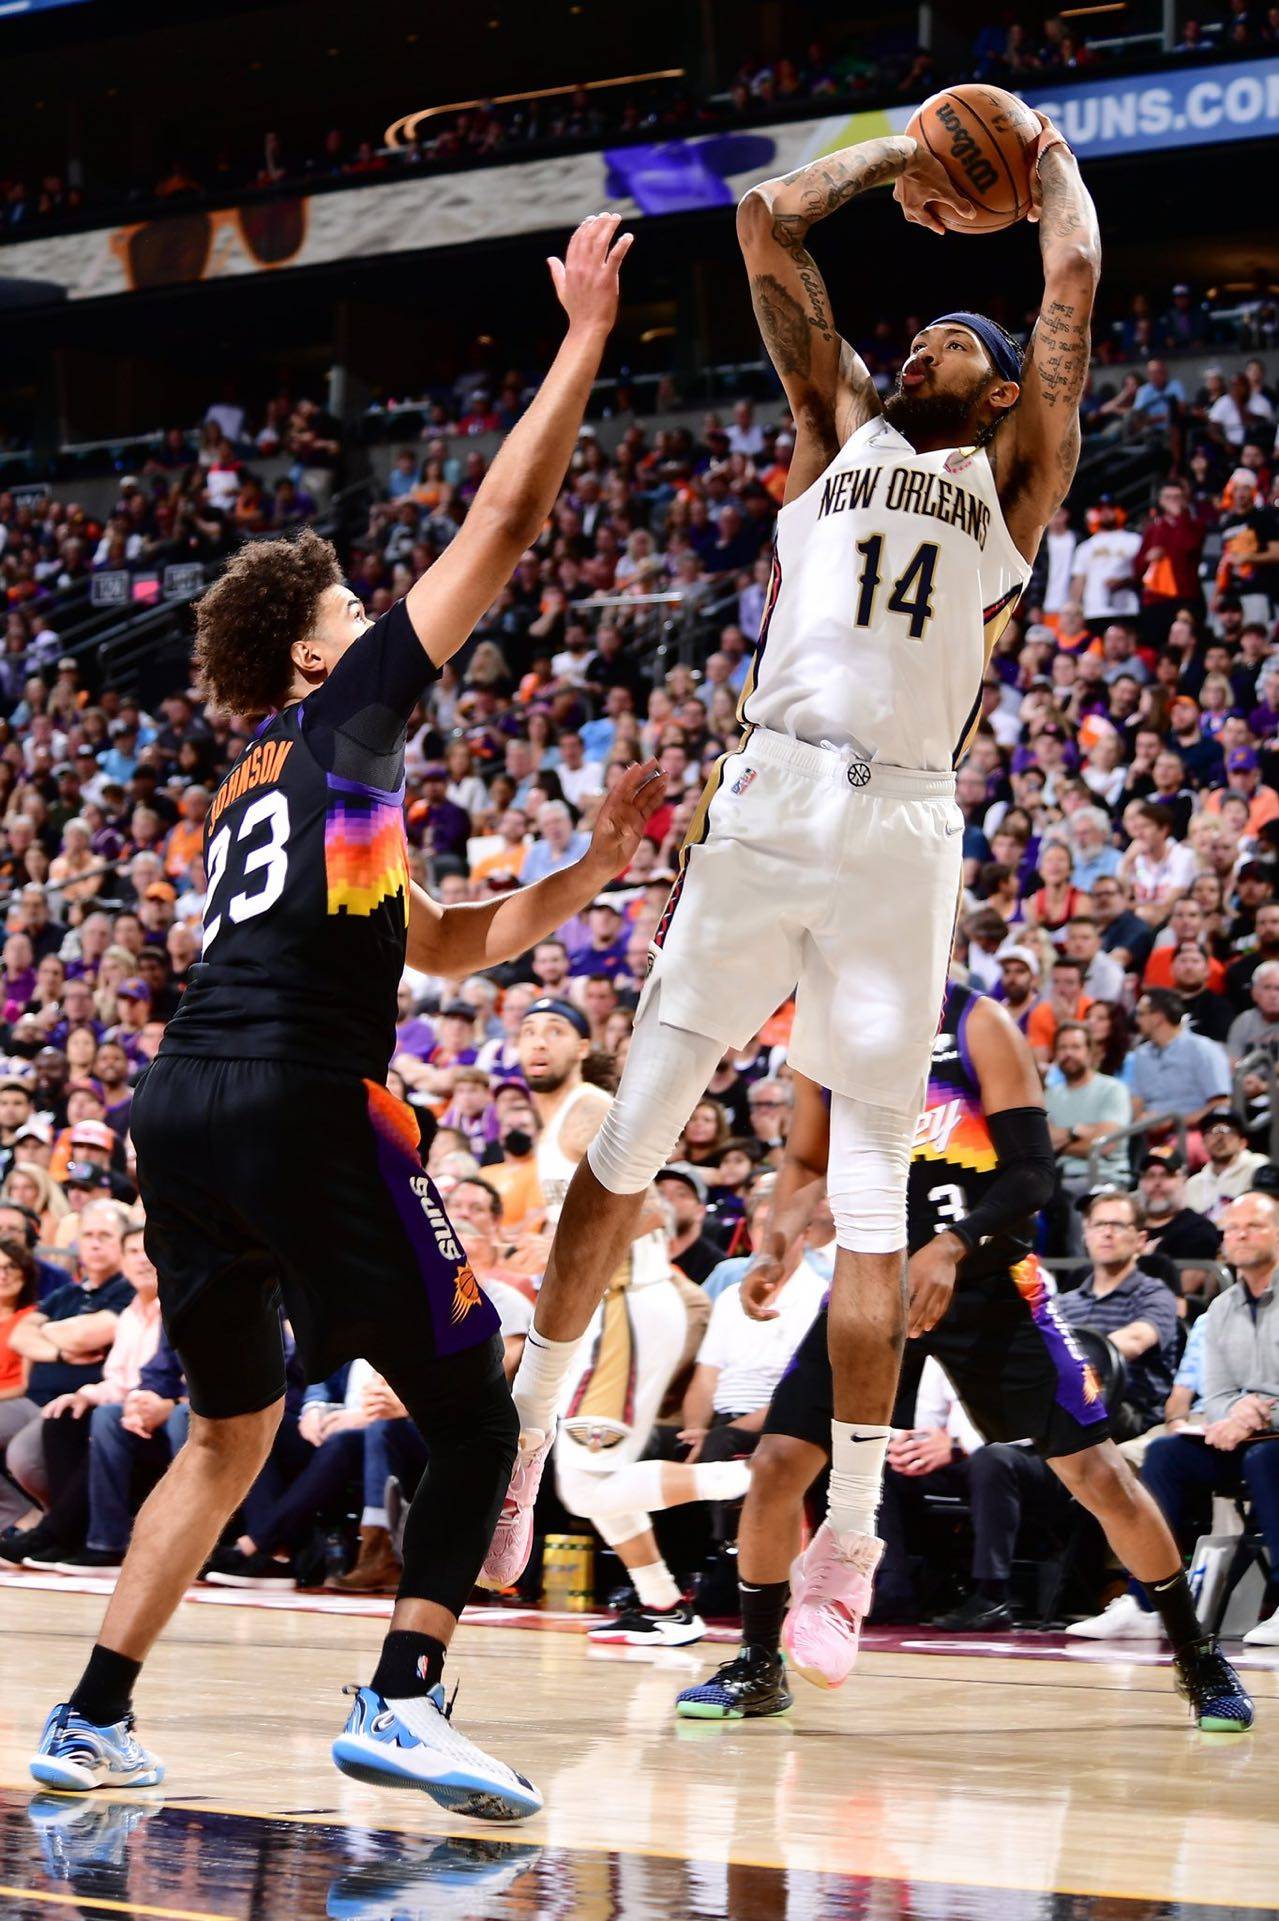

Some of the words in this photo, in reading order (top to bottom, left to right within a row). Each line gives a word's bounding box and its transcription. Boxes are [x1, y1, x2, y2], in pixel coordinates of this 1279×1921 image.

[936, 102, 998, 195] Wilson
[817, 466, 882, 521] NEW
[885, 468, 991, 552] ORLEANS
[854, 532, 941, 640] 14
[207, 740, 293, 838] JOHNSON
[202, 789, 290, 960] 23
[927, 1183, 966, 1234] 3
